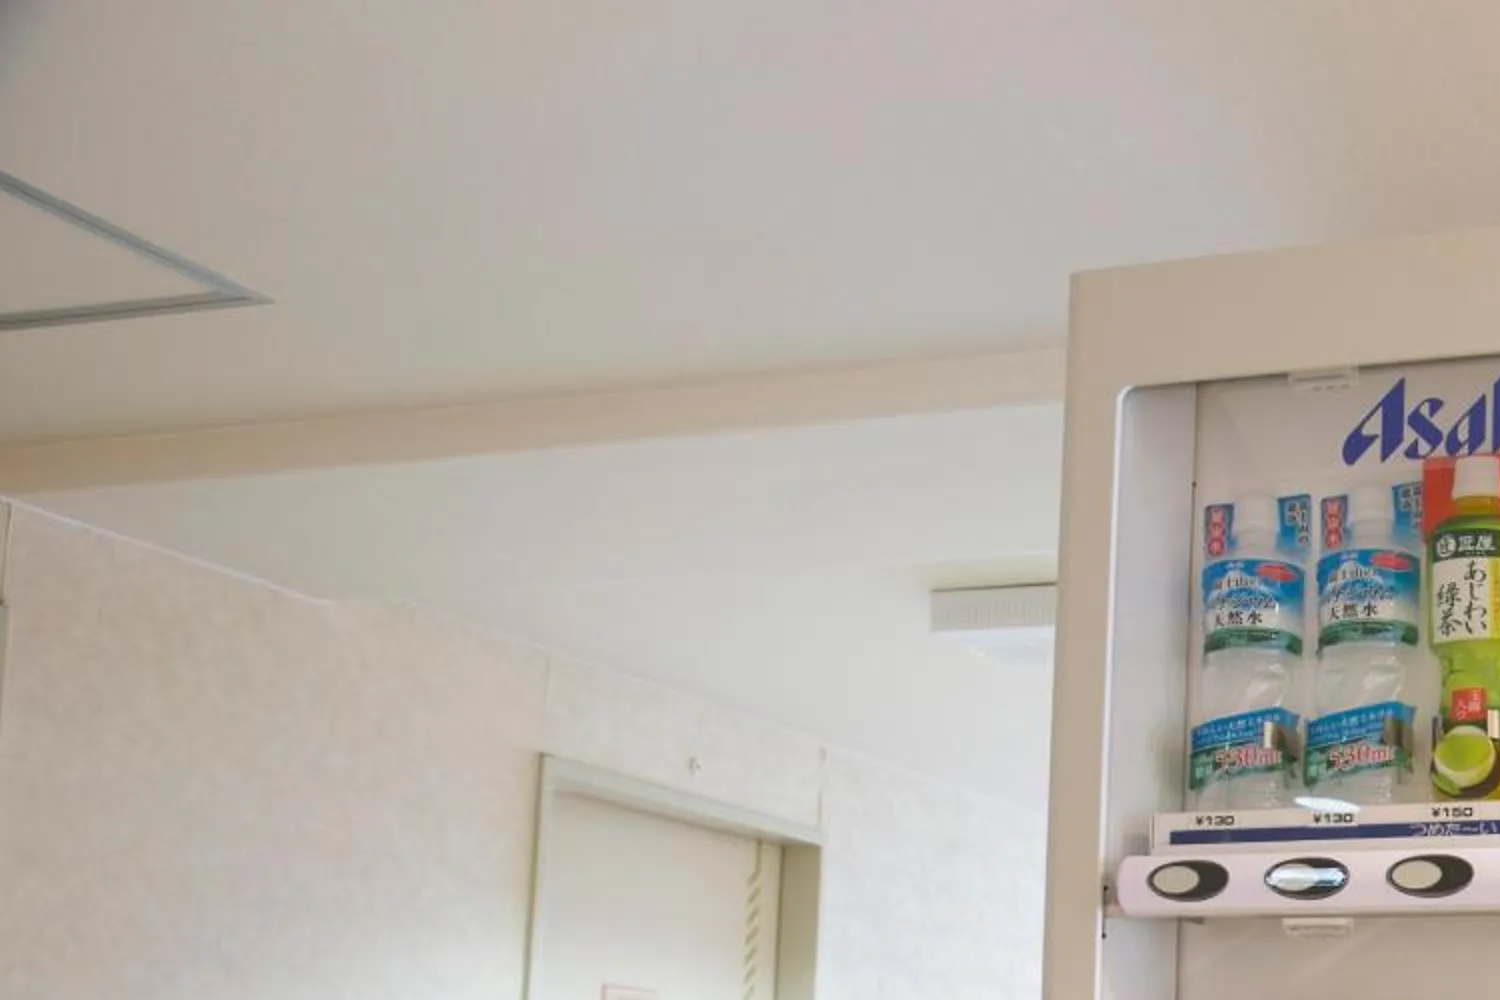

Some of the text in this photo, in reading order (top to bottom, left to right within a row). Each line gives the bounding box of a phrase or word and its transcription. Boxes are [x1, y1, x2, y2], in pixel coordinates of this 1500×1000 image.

[1313, 812, 1354, 824] ¥130
[1432, 807, 1473, 818] ¥150
[1195, 815, 1235, 826] ¥130
